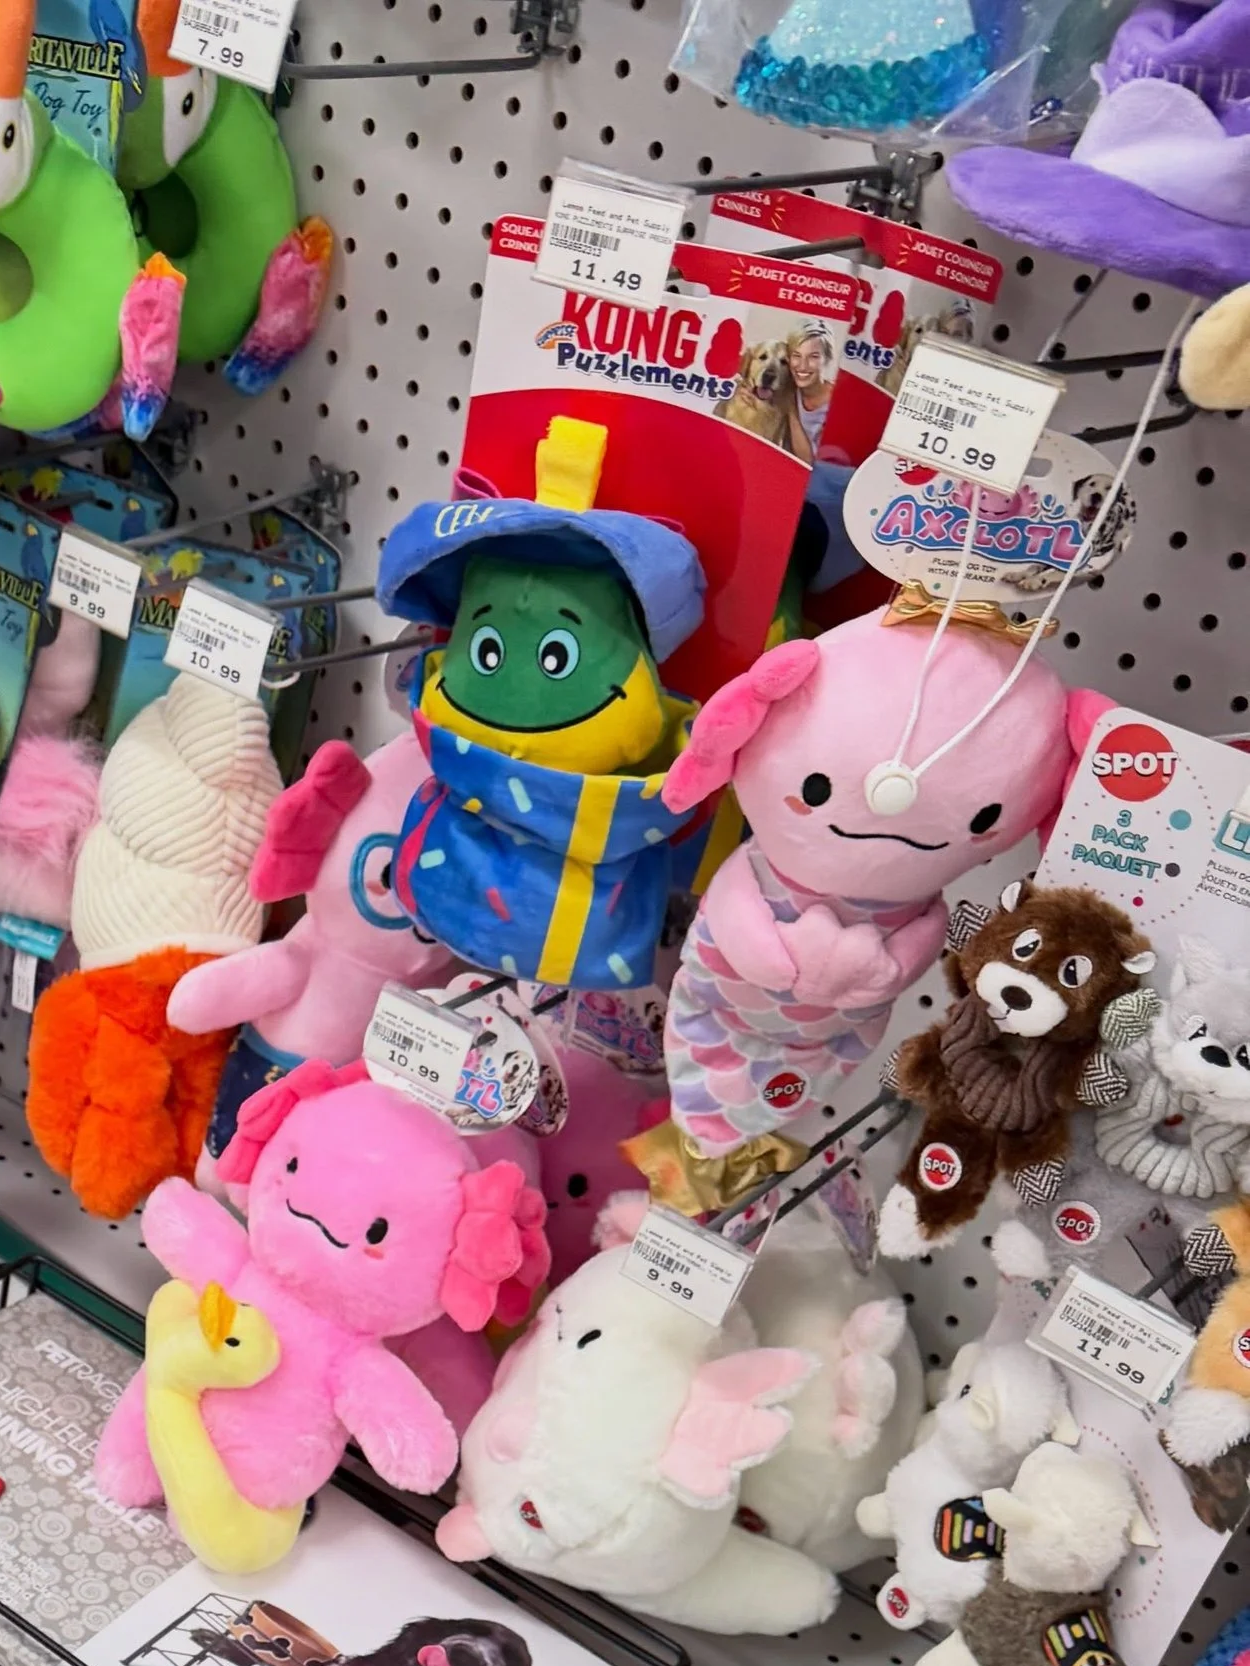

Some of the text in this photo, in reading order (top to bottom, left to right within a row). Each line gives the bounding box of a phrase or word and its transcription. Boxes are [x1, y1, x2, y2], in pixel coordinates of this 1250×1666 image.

[29, 33, 124, 80] RITAVILLE
[198, 38, 245, 68] 7.99
[69, 89, 106, 129] Toy
[717, 197, 762, 218] CRINKLES
[572, 258, 642, 291] 11.49
[913, 241, 995, 278] JOUET COUINEUR
[746, 265, 851, 295] JOUET COUINEUR
[935, 264, 991, 293] ET SONORE
[778, 288, 847, 312] ET SONORE
[562, 289, 703, 369] KONG
[557, 342, 735, 399] Puzzlements
[967, 387, 983, 398] and
[986, 391, 1001, 405] Pet
[1005, 399, 1035, 416] Supply
[918, 431, 997, 471] 10.99
[879, 501, 1085, 562] AXOLOTL
[928, 567, 949, 577] WITH
[69, 593, 106, 619] 9.99
[0, 609, 24, 641] Toy
[190, 650, 241, 684] 10.99
[1092, 752, 1178, 777] SPOT
[1117, 809, 1132, 828] 3
[1091, 825, 1149, 853] PACK
[1072, 843, 1161, 880] PAQUET
[1208, 860, 1238, 877] PLUSH
[1198, 882, 1222, 897] AVEC
[1201, 872, 1238, 892] JOUETS
[387, 1049, 440, 1084] 10.99
[764, 1081, 806, 1102] SPOT
[924, 1156, 955, 1176] SPOT
[1055, 1215, 1096, 1234] SPOT
[647, 1268, 694, 1300] 9.99
[1123, 1317, 1138, 1330] and
[1155, 1336, 1182, 1357] Supply
[1077, 1338, 1145, 1385] 11.99
[887, 1591, 909, 1615] SPOT
